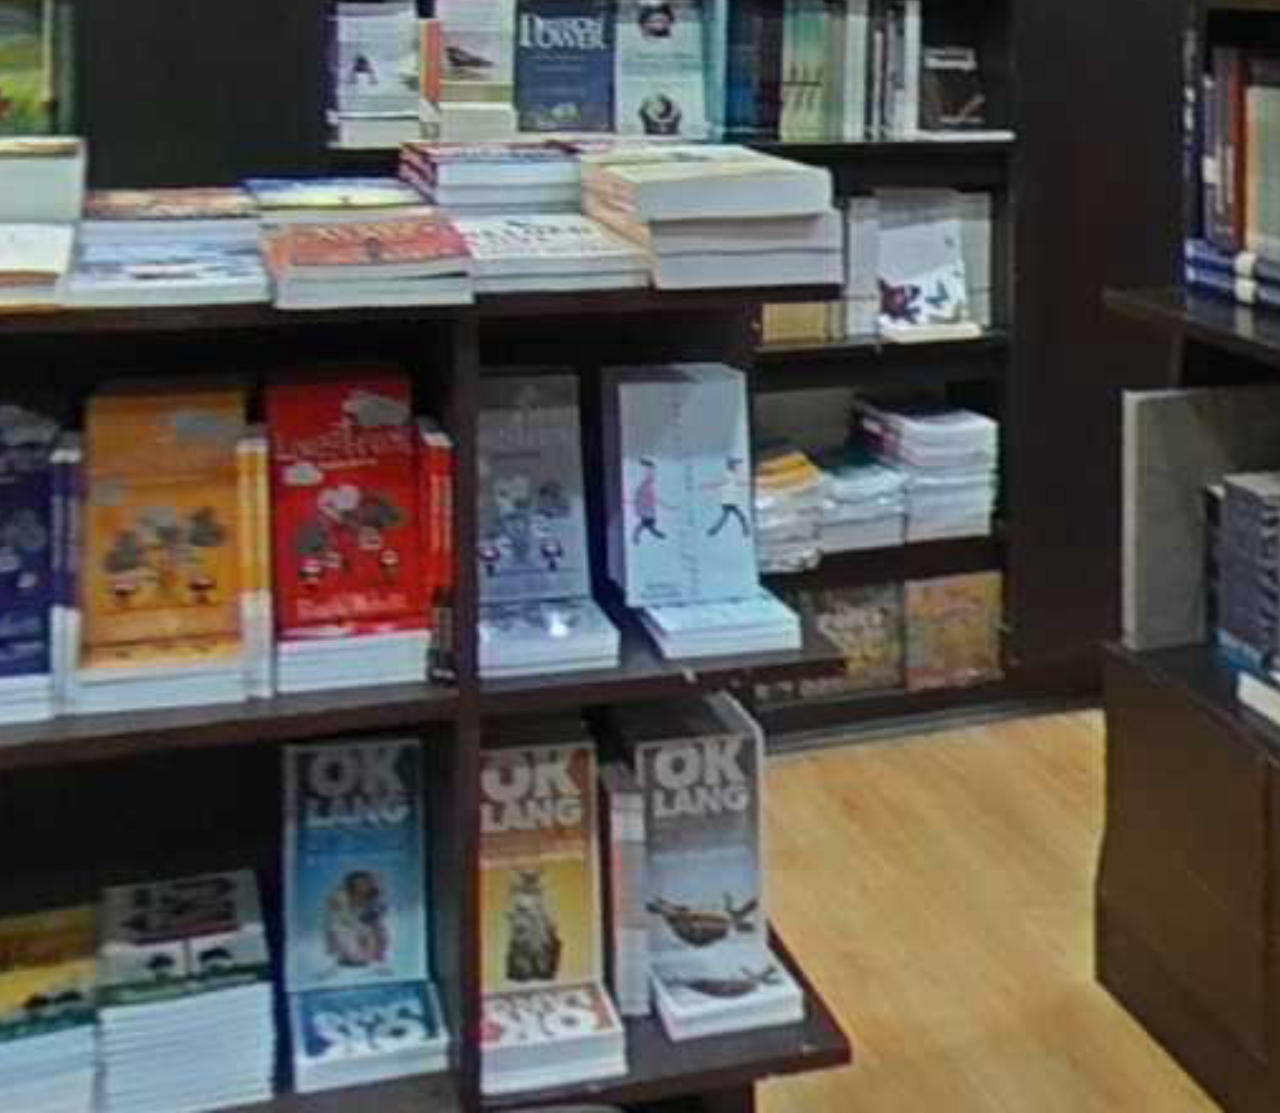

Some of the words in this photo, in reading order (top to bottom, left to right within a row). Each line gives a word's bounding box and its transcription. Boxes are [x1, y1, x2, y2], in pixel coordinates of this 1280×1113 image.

[307, 747, 412, 796] OK
[479, 750, 580, 800] OK
[654, 739, 748, 790] OK
[305, 794, 411, 827] LANG
[477, 798, 582, 832] LANG
[651, 784, 750, 819] LANG
